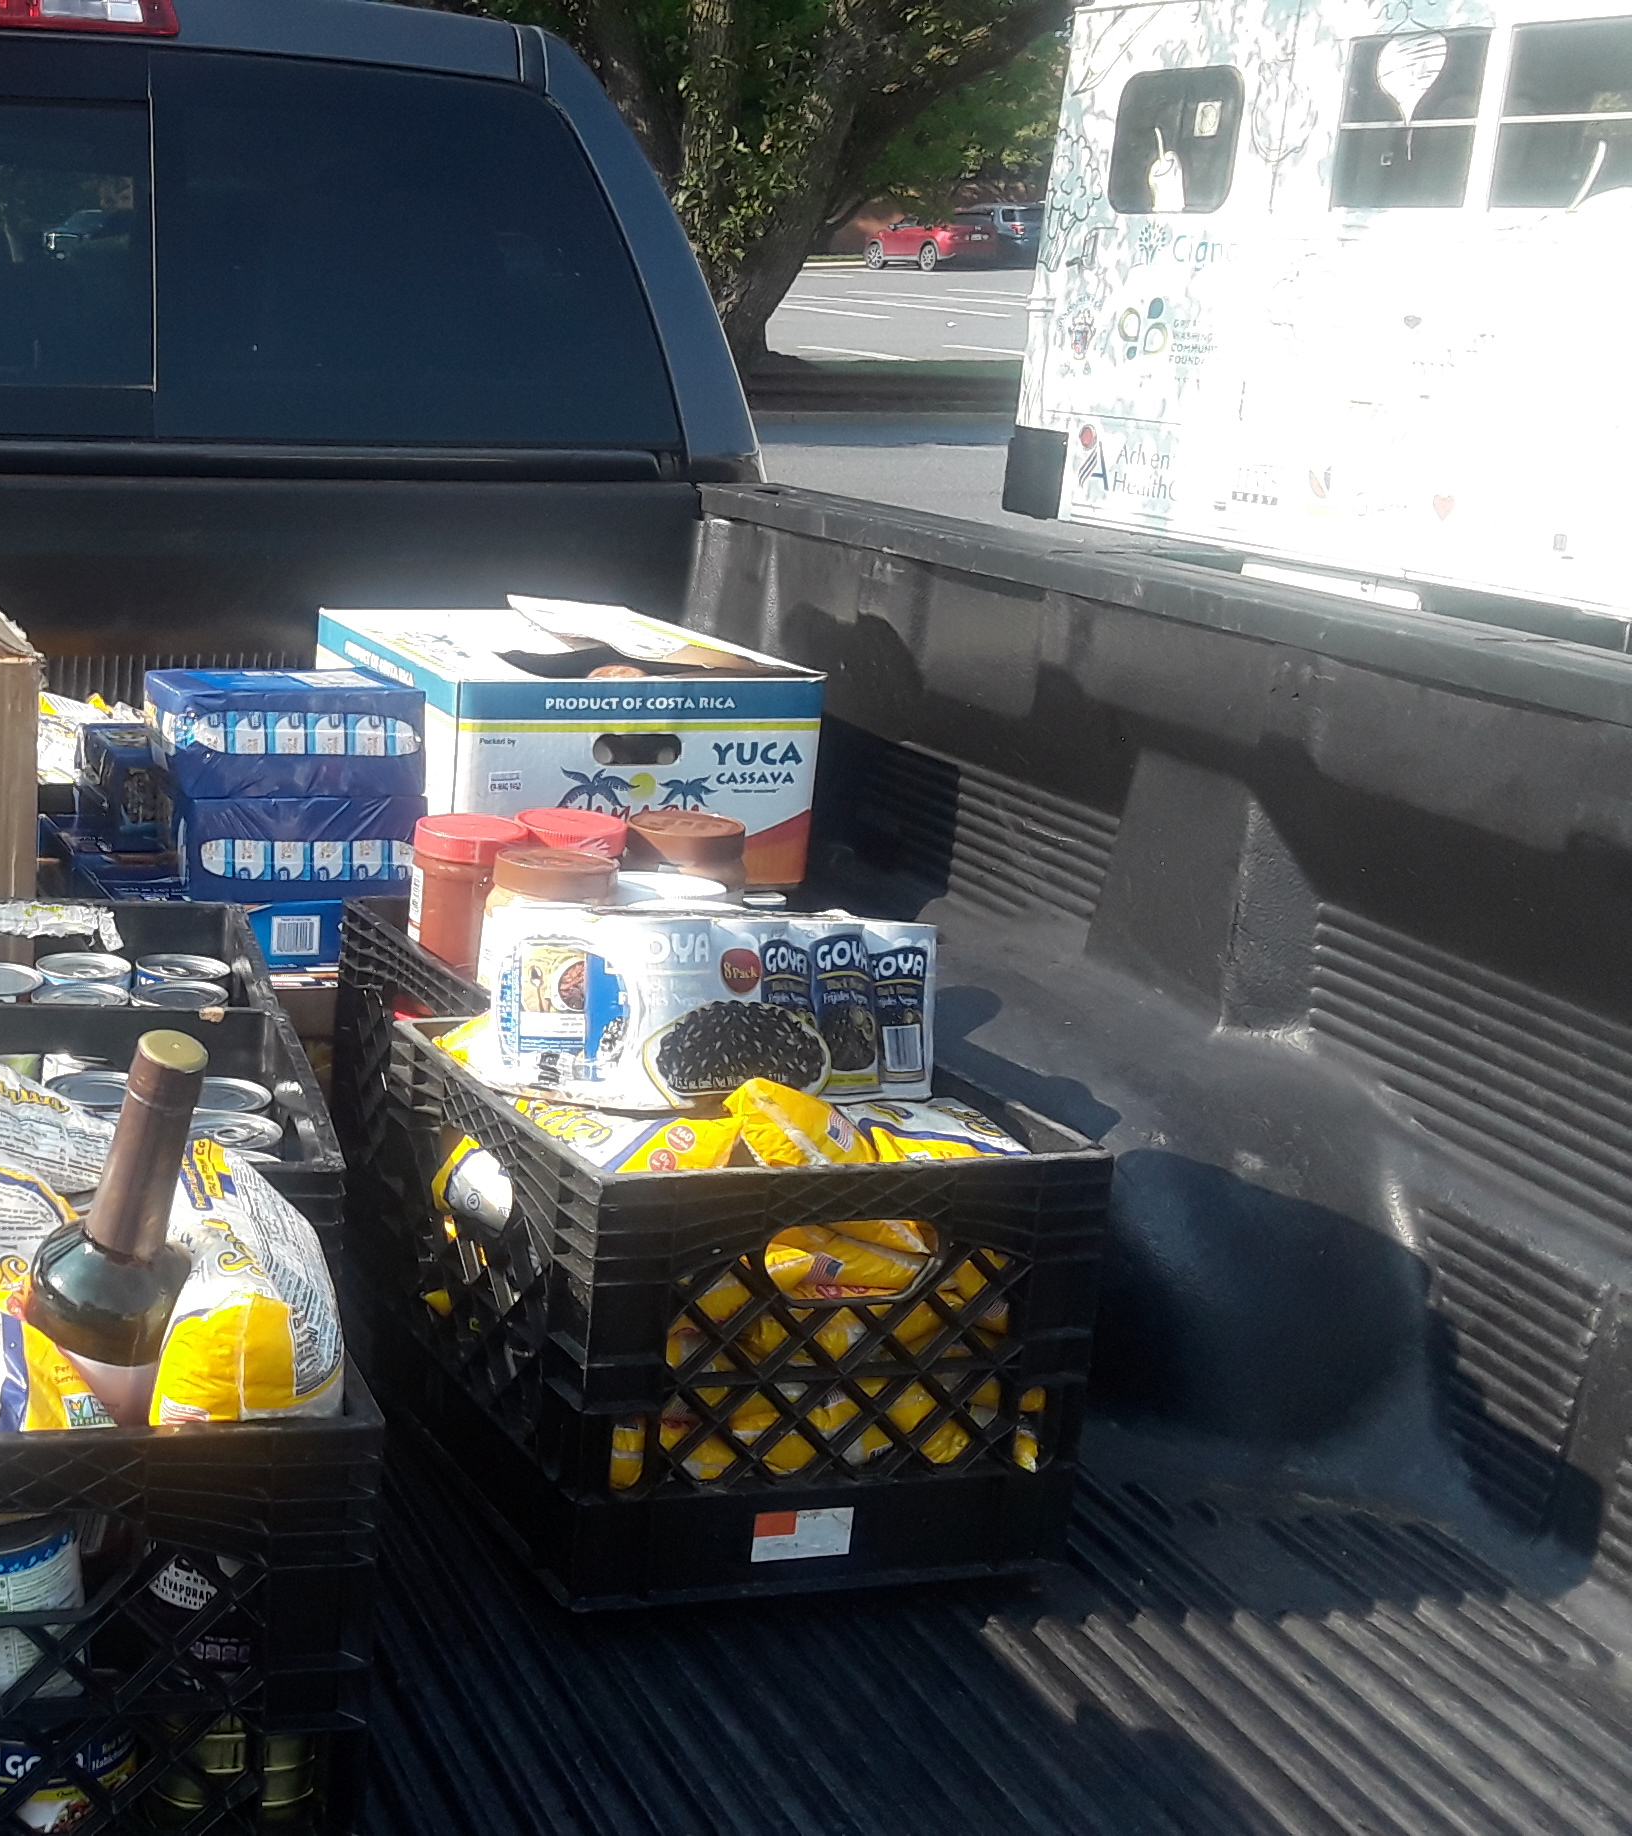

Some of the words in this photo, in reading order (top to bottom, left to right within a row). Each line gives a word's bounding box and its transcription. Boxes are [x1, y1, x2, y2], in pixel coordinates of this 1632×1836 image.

[544, 697, 620, 711] PRODUCT
[622, 697, 643, 711] OF
[646, 697, 696, 711] COSTA
[699, 697, 737, 710] RICA
[712, 741, 804, 766] YUCA
[715, 770, 796, 786] CASSAVA
[645, 931, 711, 964] OYA
[765, 946, 808, 975] GOYA
[817, 940, 869, 972] GOYA
[871, 954, 924, 980] GOYA
